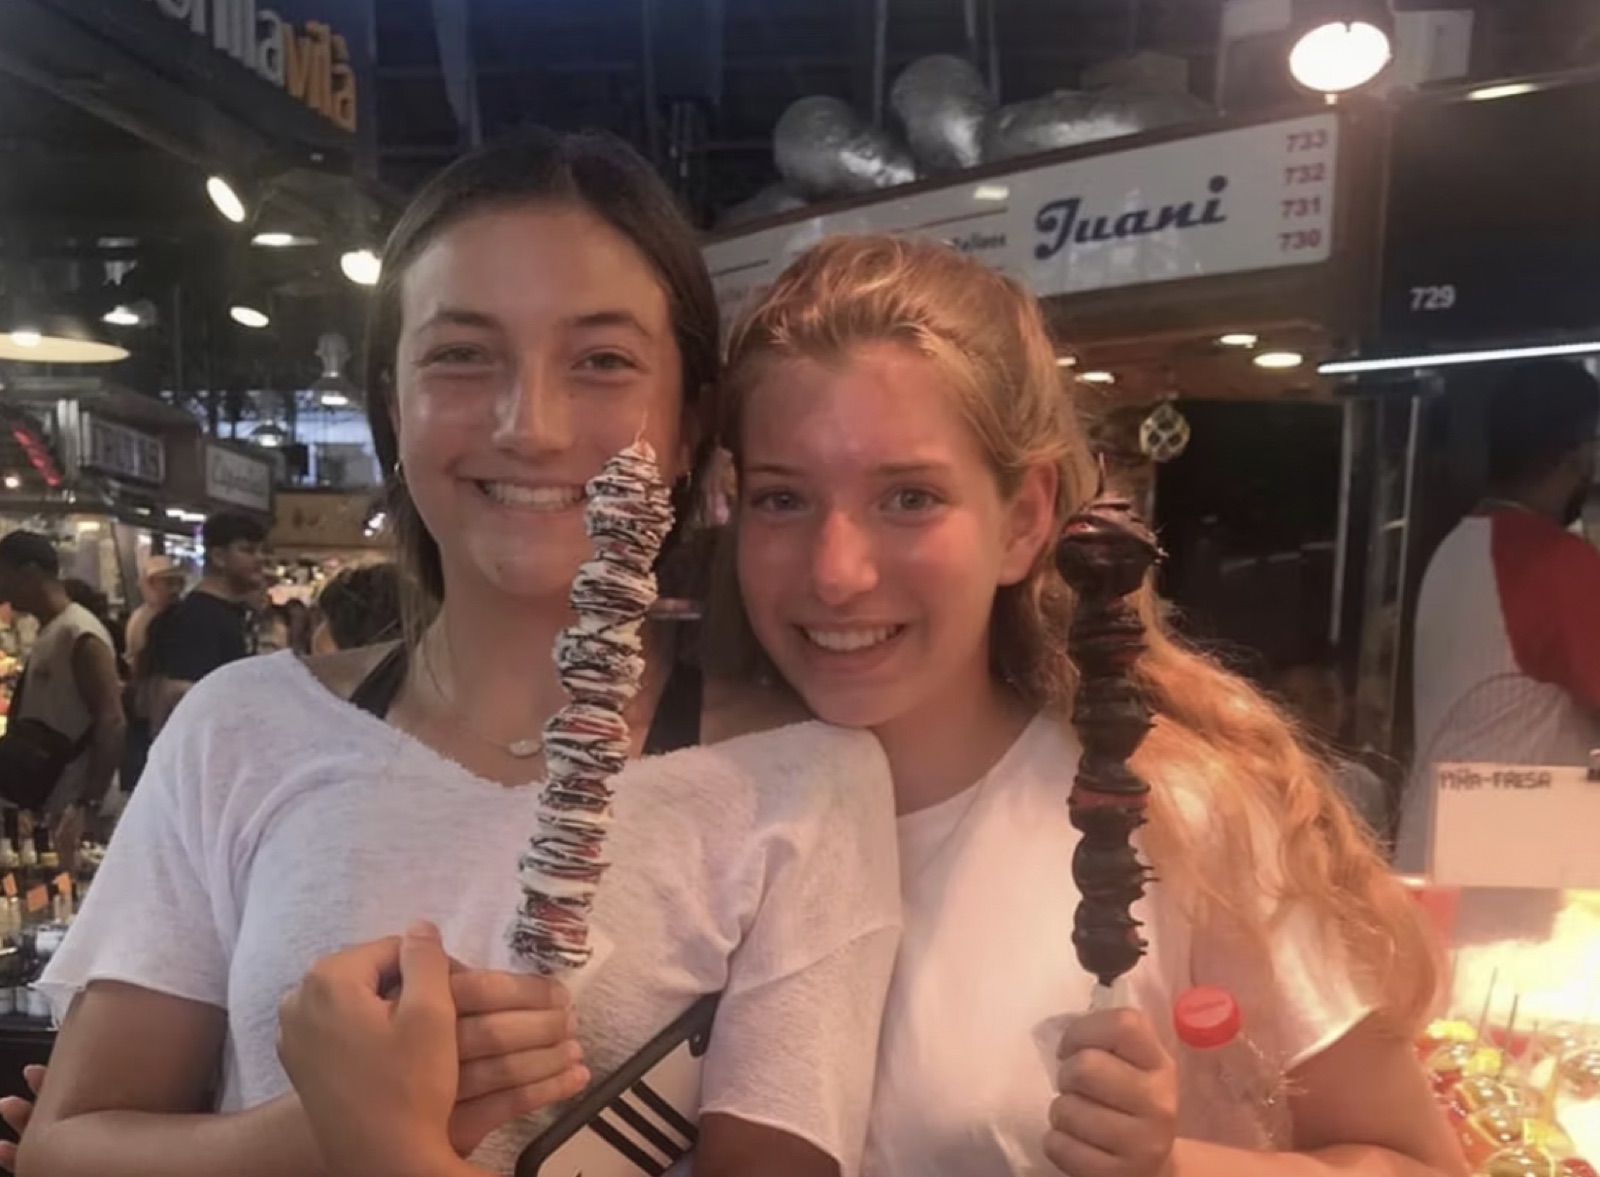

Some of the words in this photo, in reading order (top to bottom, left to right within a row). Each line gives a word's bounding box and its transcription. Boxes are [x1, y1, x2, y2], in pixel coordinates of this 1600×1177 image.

[1286, 129, 1328, 153] 733
[1284, 163, 1326, 186] 732
[1034, 175, 1229, 260] Juani
[1281, 196, 1322, 219] 731
[1278, 228, 1322, 251] 730
[1409, 284, 1456, 311] 729
